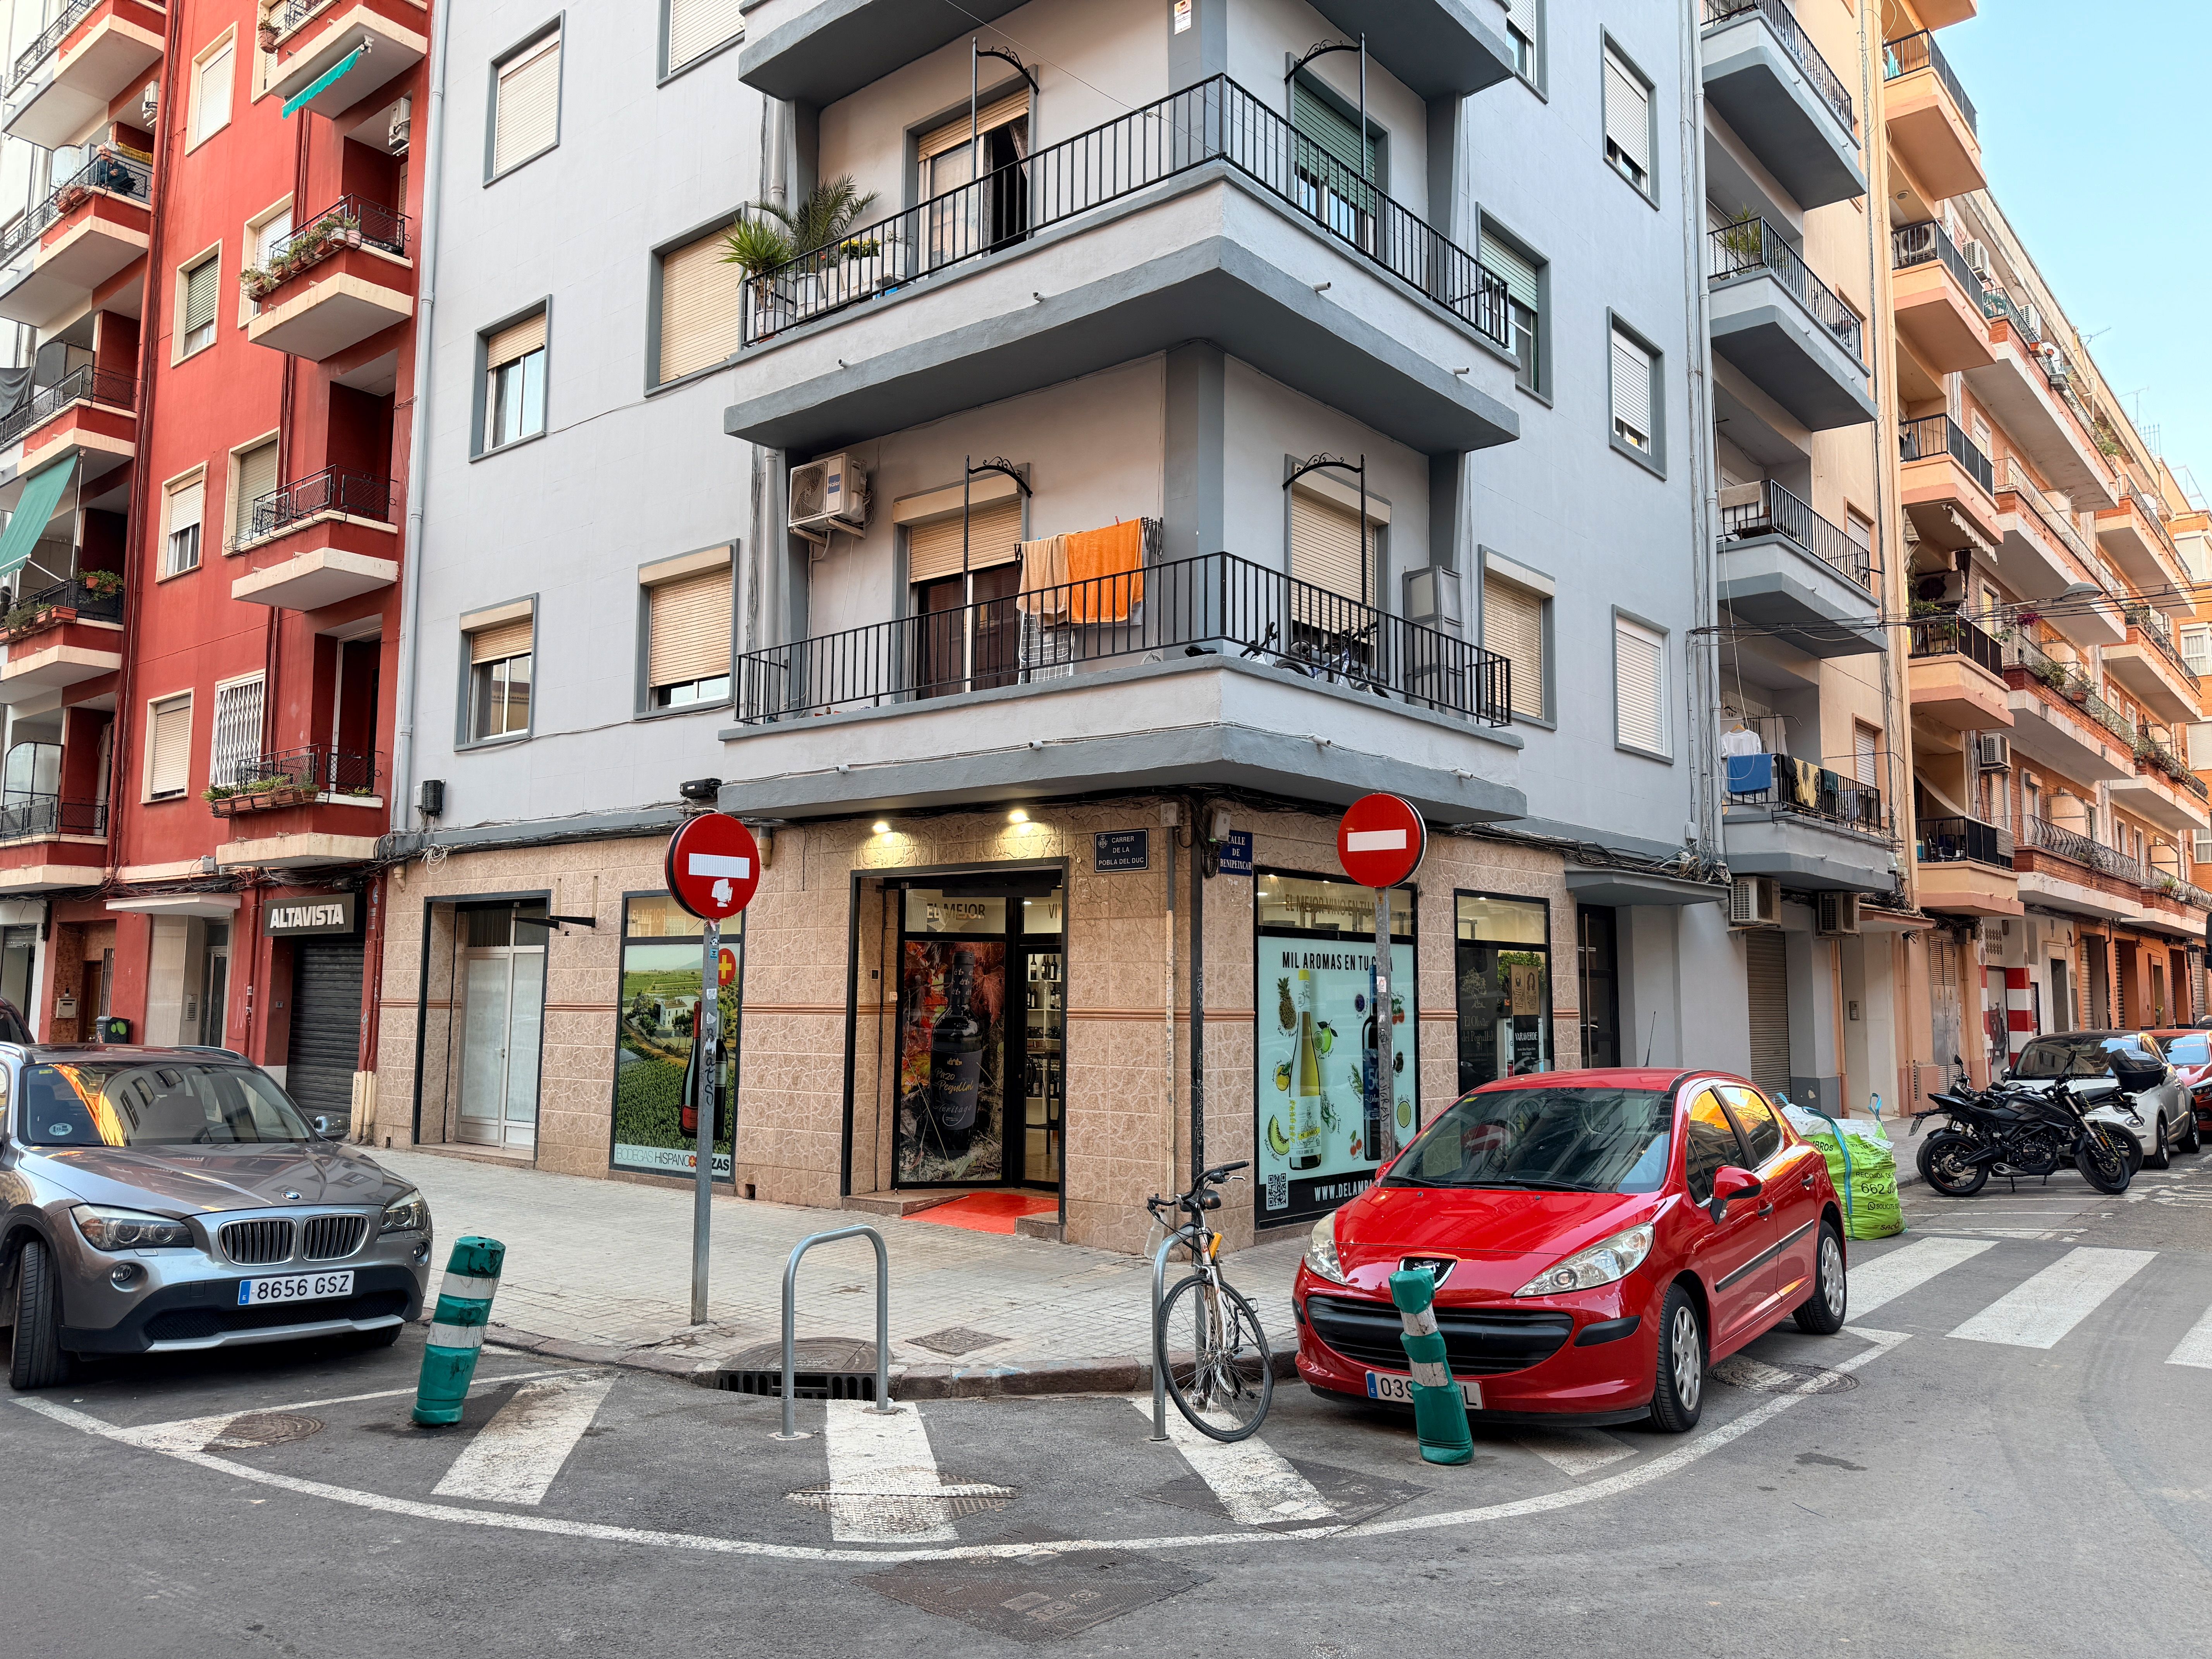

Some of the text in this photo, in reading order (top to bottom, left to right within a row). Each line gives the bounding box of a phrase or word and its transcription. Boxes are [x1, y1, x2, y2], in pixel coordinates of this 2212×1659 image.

[1232, 848, 1240, 857] DE
[1220, 858, 1252, 870] BENIPEIXCAR
[927, 903, 939, 919] EL
[944, 903, 986, 920] MEJOR
[1285, 894, 1294, 912] EL
[1297, 895, 1324, 914] MEJOR
[1326, 897, 1345, 916] VINO
[1348, 900, 1357, 917] EN
[270, 903, 344, 928] ALTAVISTA
[641, 908, 666, 923] MEJOR
[1282, 951, 1299, 969] MIL
[1303, 952, 1342, 970] AROMAS
[1345, 955, 1355, 970] EN
[1358, 955, 1369, 971] TU
[1464, 1015, 1489, 1027] El Olivar
[1515, 1032, 1538, 1041] VARAVERDE
[616, 1147, 653, 1163] BODEGAS
[654, 1152, 690, 1167] HISPANO
[1861, 1183, 1885, 1194] 662
[257, 1274, 349, 1300] 8656 GSZ
